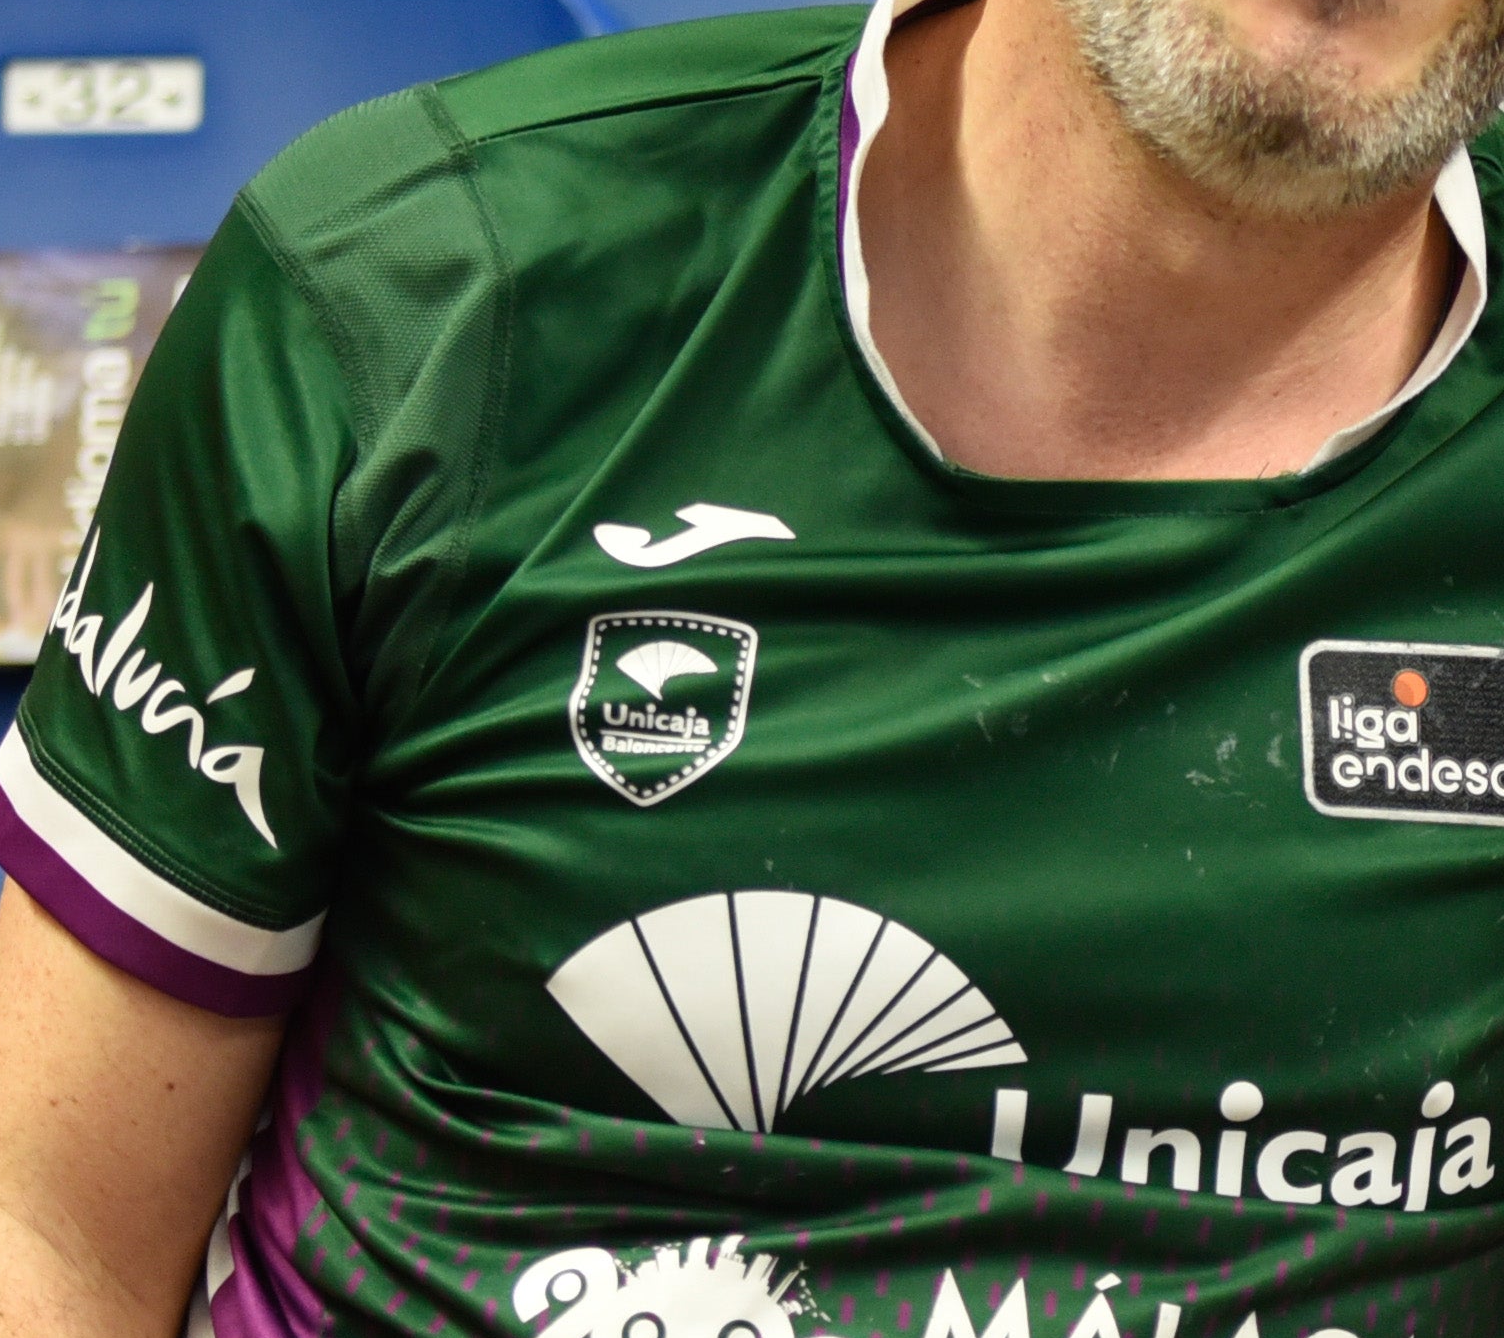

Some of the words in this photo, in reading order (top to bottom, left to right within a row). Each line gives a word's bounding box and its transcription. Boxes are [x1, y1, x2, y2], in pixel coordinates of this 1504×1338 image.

[54, 59, 151, 128] 32
[603, 703, 710, 740] Unicaja
[1328, 694, 1419, 749] liga
[991, 1080, 1495, 1212] Unicaja
